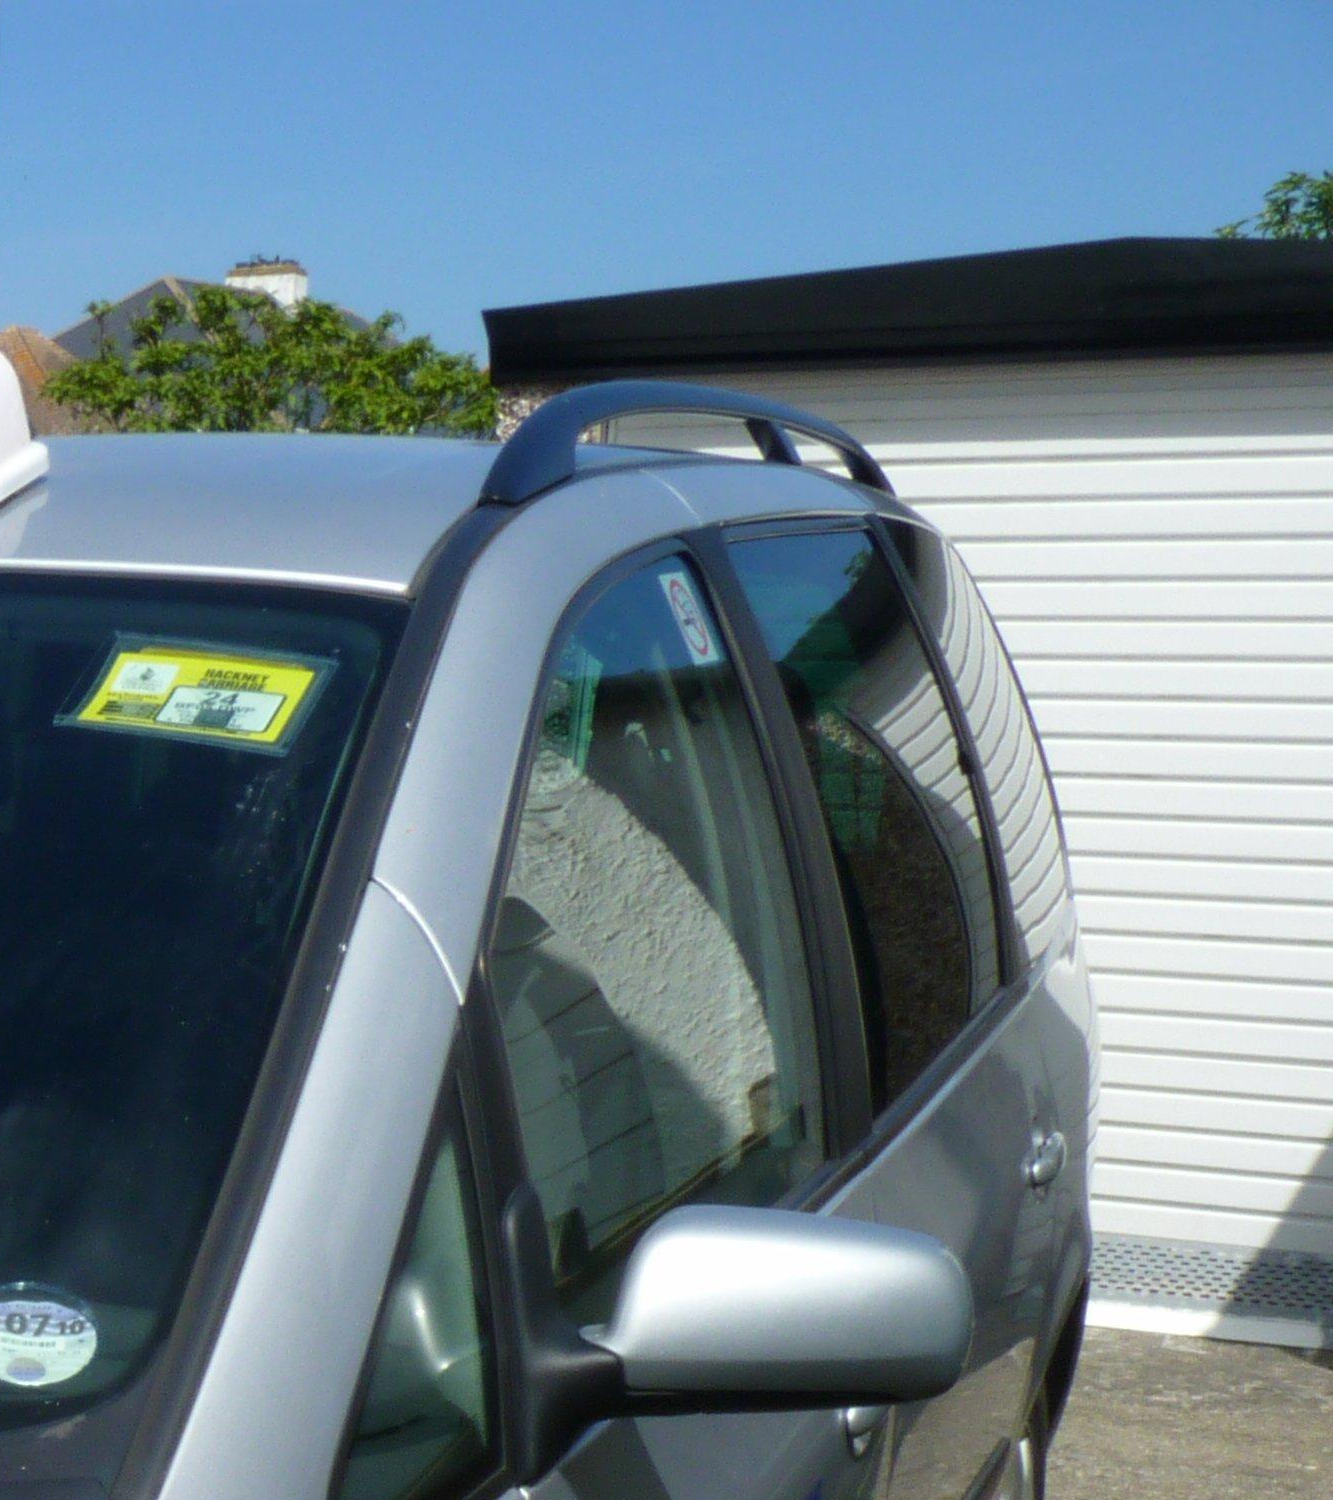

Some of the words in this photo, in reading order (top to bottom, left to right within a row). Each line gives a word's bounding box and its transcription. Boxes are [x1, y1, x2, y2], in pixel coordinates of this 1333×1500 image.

[203, 667, 271, 685] HACKNEY
[200, 690, 241, 707] 24
[5, 1312, 51, 1336] 07
